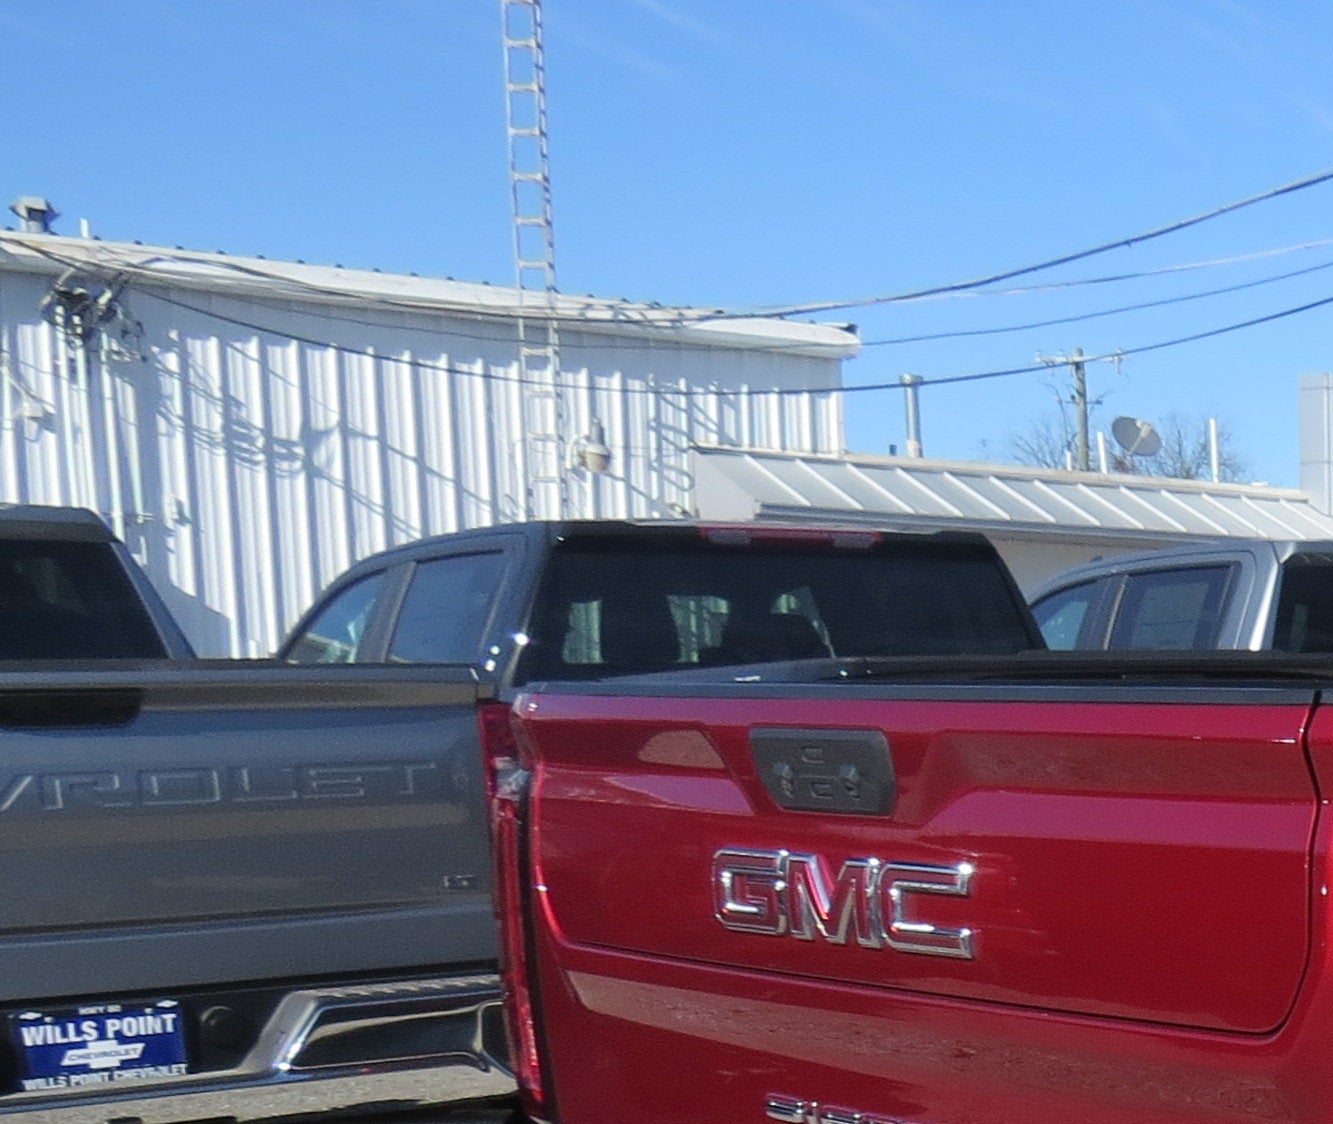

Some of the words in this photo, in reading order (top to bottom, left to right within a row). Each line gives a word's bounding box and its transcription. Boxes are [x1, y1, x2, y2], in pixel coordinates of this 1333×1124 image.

[711, 848, 974, 960] GMC
[20, 1020, 99, 1046] WILLS
[105, 1013, 177, 1038] POINT
